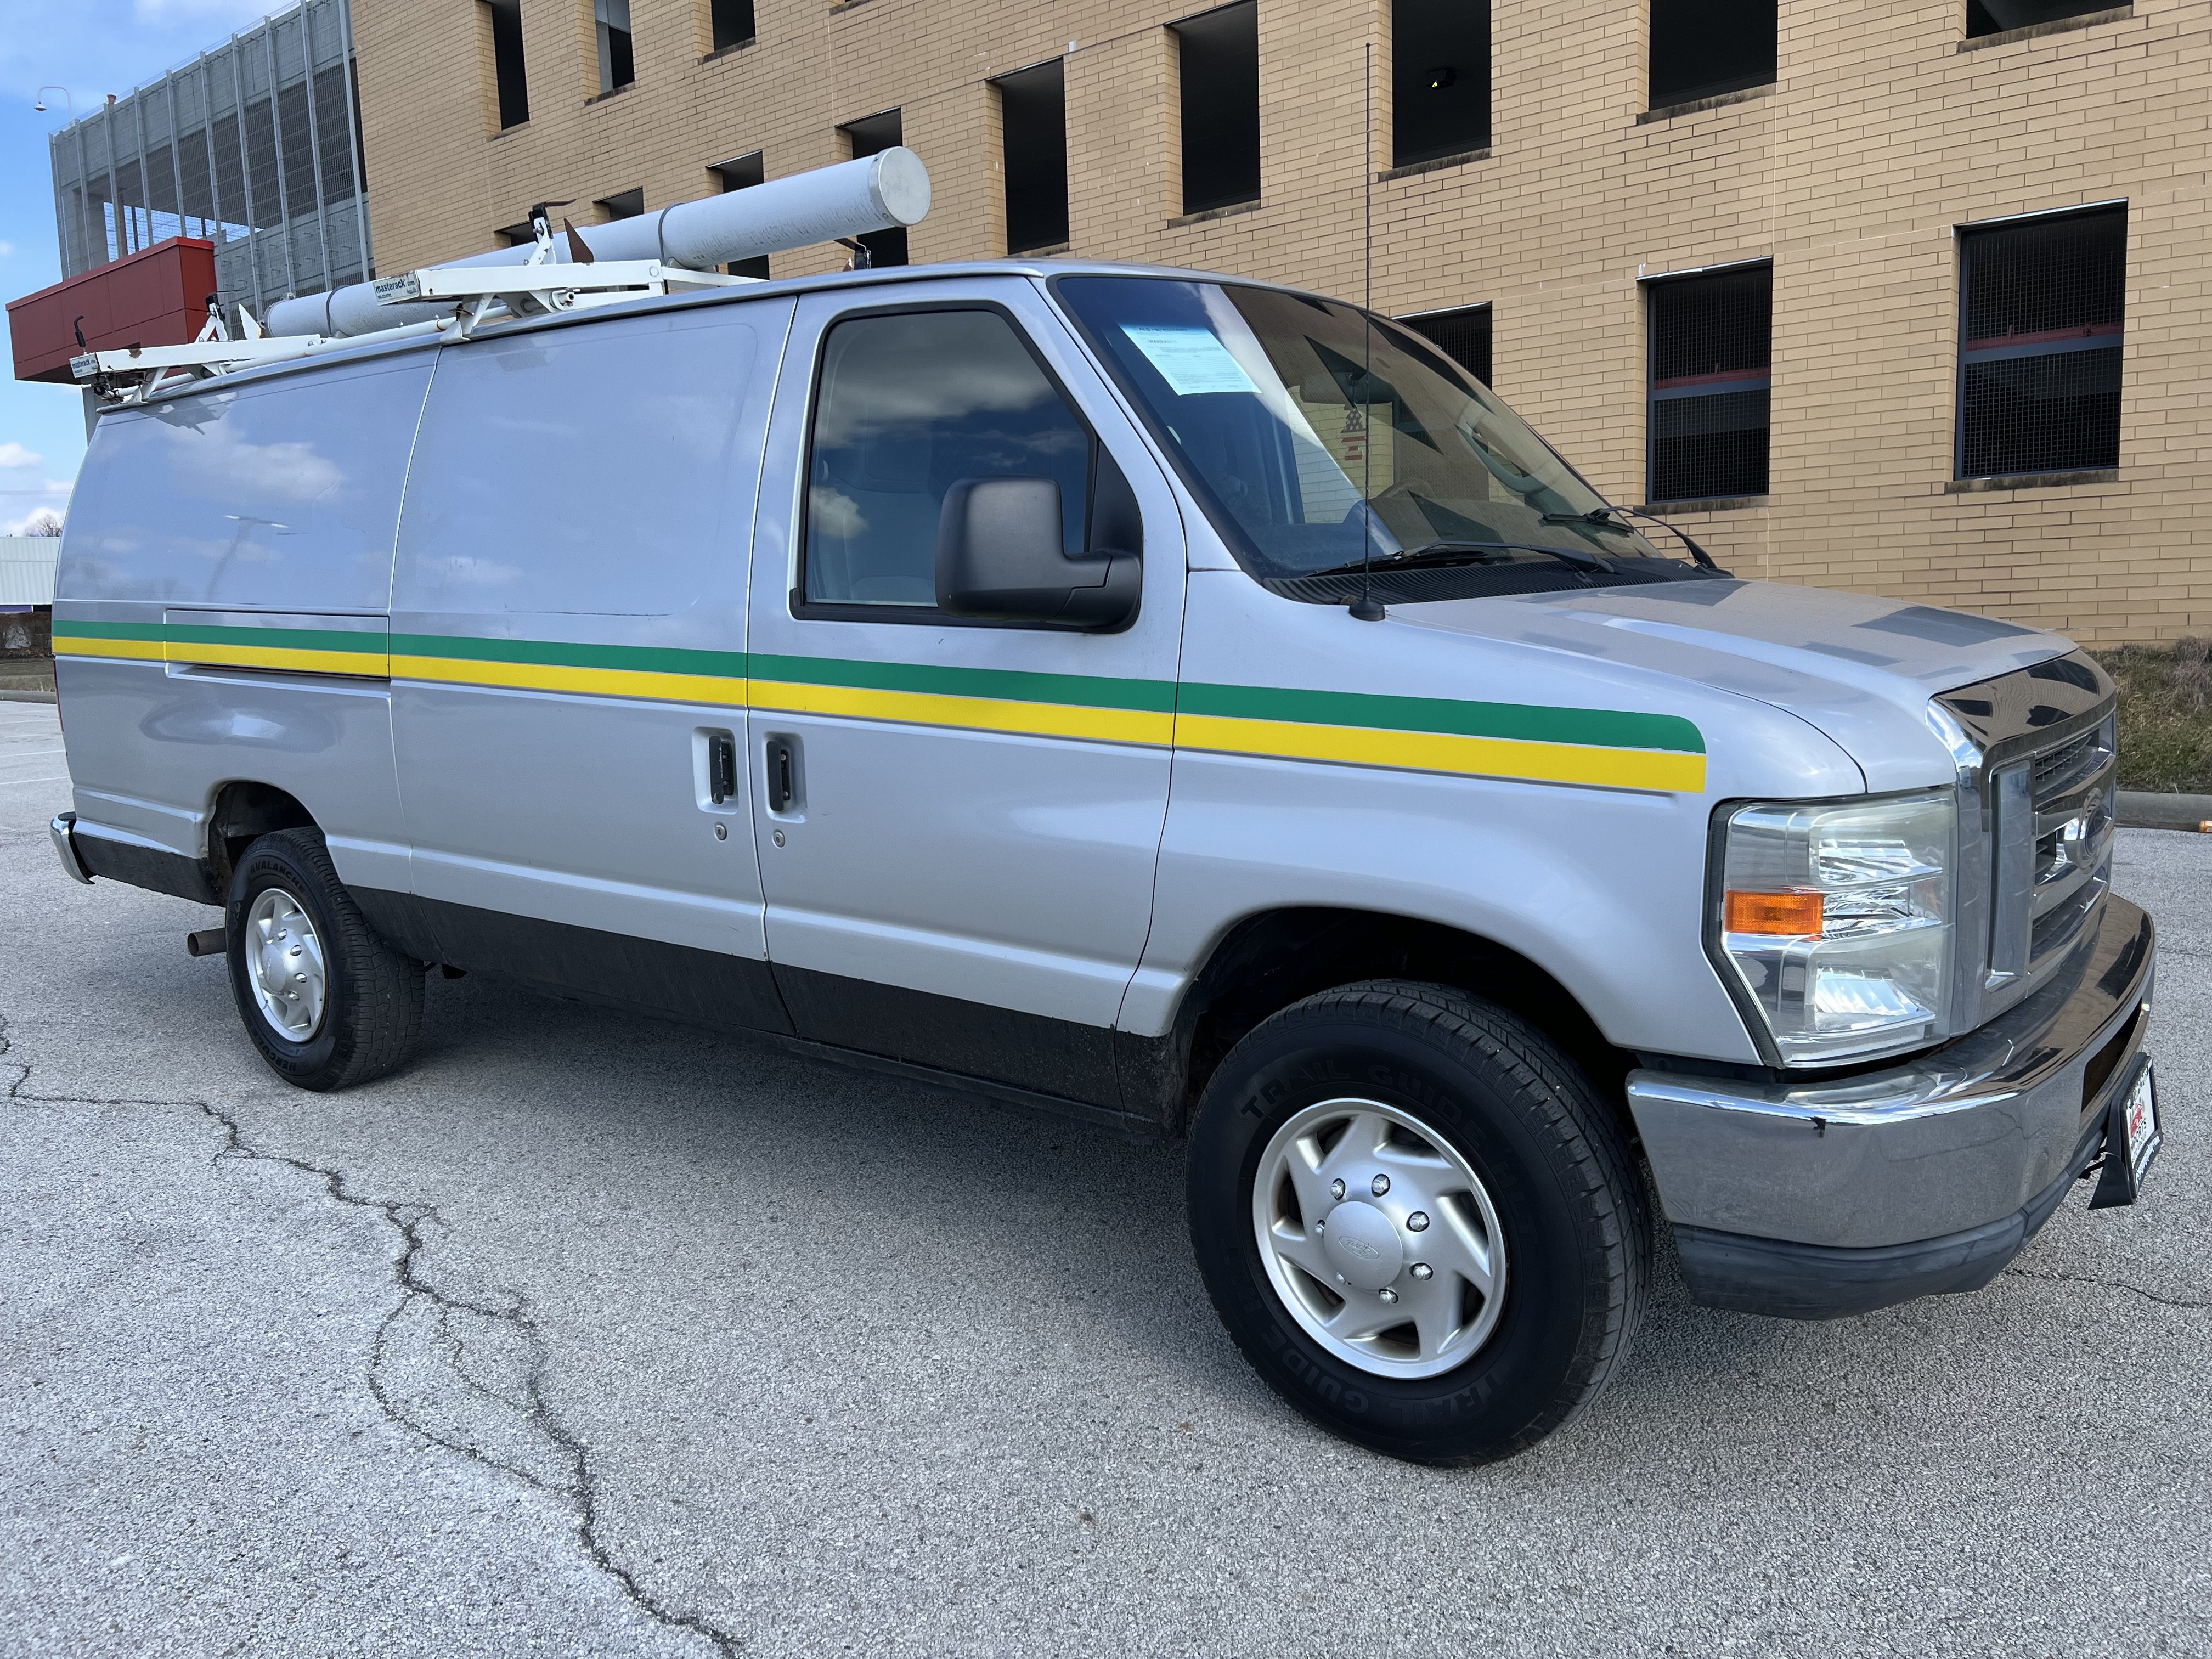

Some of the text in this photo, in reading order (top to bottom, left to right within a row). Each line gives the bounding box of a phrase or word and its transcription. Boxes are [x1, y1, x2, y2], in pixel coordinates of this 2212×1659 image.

[250, 860, 306, 894] AVALANCHE
[246, 1016, 297, 1071] HERCULES
[1240, 1060, 1351, 1119] TRAIL
[1368, 1064, 1488, 1149] GUIDE
[1260, 1324, 1370, 1414] GUIDE
[1389, 1373, 1507, 1425] TRAIL
